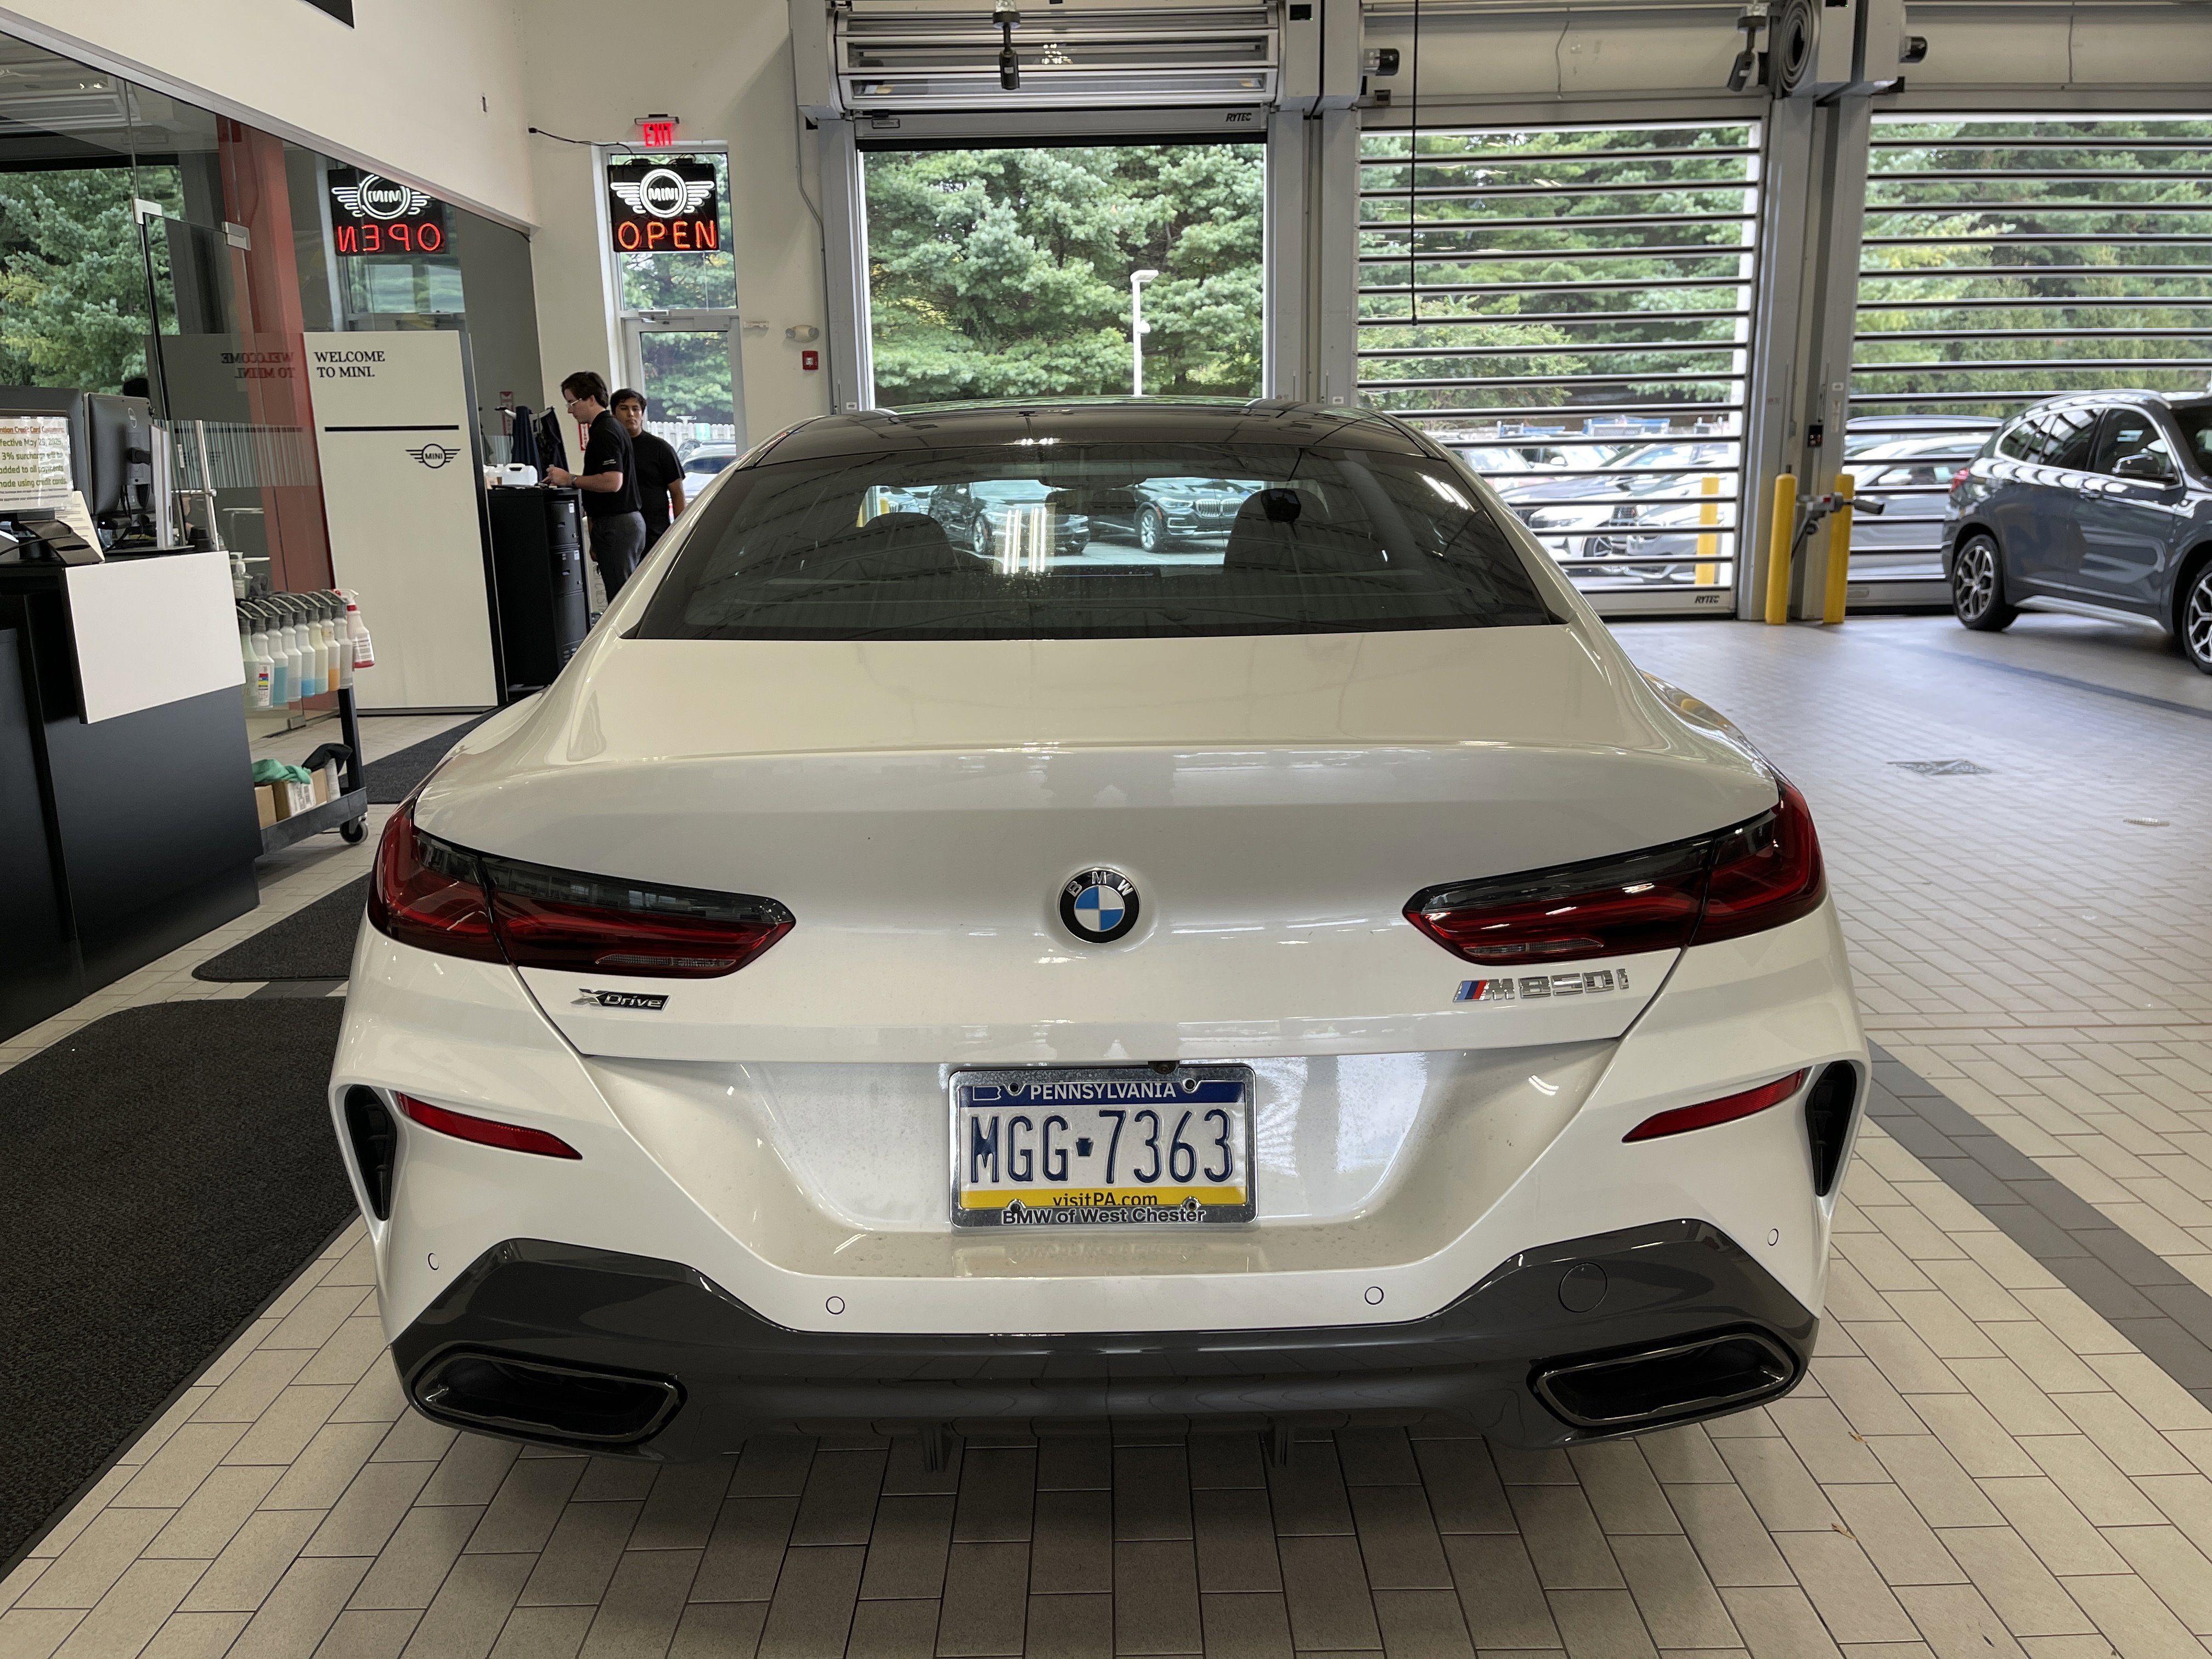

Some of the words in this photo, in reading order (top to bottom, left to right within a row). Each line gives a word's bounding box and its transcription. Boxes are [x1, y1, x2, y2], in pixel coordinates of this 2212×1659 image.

[1226, 112, 1252, 122] RYTEC
[643, 123, 673, 148] EXIT
[648, 187, 679, 201] MINI
[618, 221, 716, 250] OPEN
[314, 351, 385, 362] WELCOME
[317, 366, 335, 377] TO
[338, 366, 375, 377] MINI.
[24, 439, 37, 447] May
[2, 452, 14, 460] 3%
[18, 479, 35, 488] using
[1695, 595, 1720, 603] RYTEC
[1065, 871, 1134, 898] BMW
[1030, 1082, 1176, 1100] PENNSYLVANIA
[970, 1115, 1069, 1183] MGG
[1098, 1108, 1233, 1184] 7363
[1053, 1192, 1158, 1207] visitPA.com
[1002, 1209, 1051, 1225] BMW
[1057, 1209, 1076, 1223] of
[1080, 1209, 1127, 1224] West
[1132, 1209, 1206, 1224] Chester
